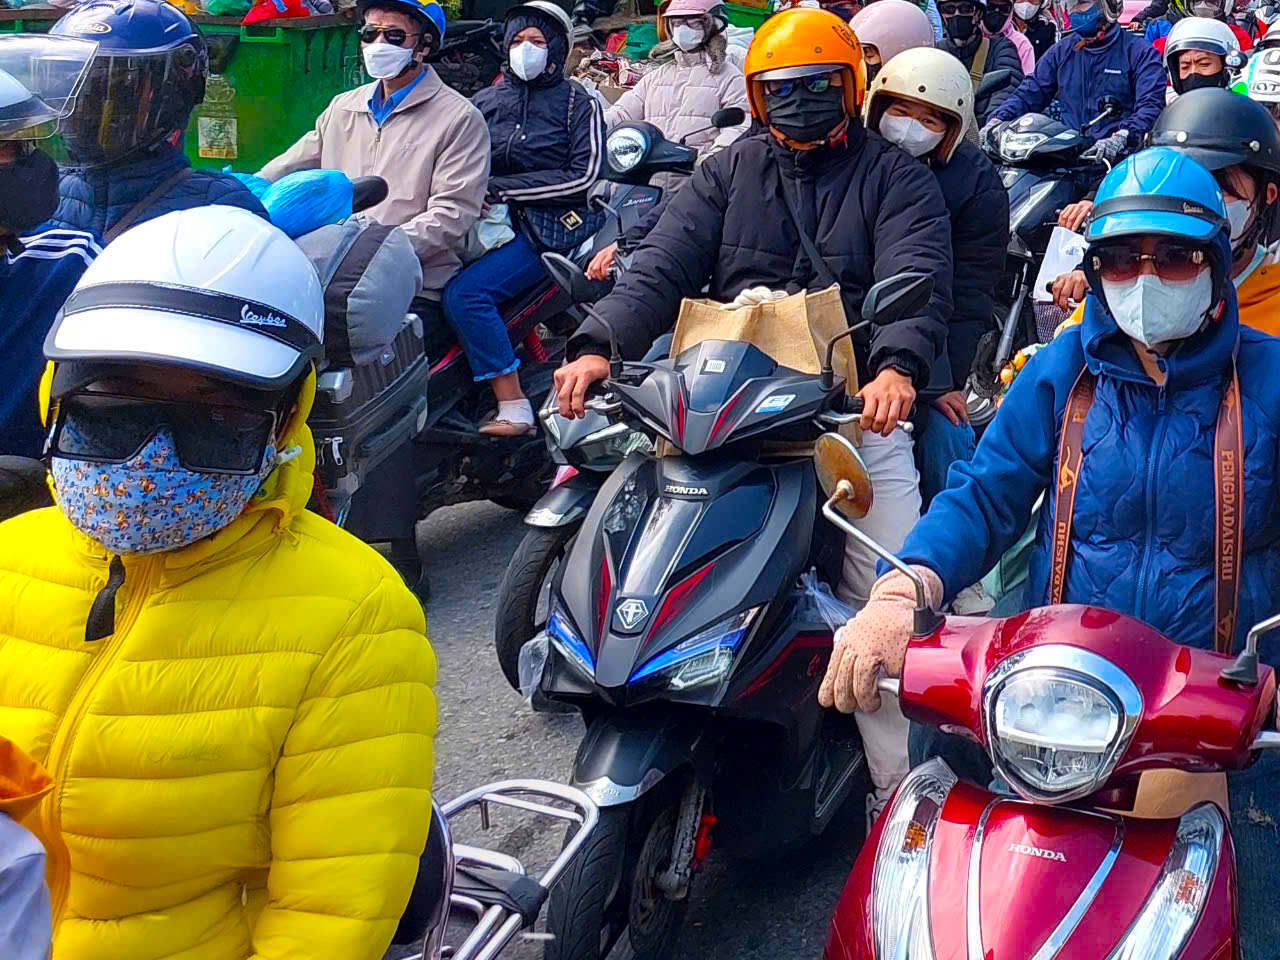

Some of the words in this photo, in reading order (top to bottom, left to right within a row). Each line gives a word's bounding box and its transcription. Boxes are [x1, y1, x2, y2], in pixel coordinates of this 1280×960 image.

[664, 485, 708, 495] HONDA
[1221, 448, 1235, 581] PENGDADAISHU
[1008, 843, 1067, 862] HONDA
